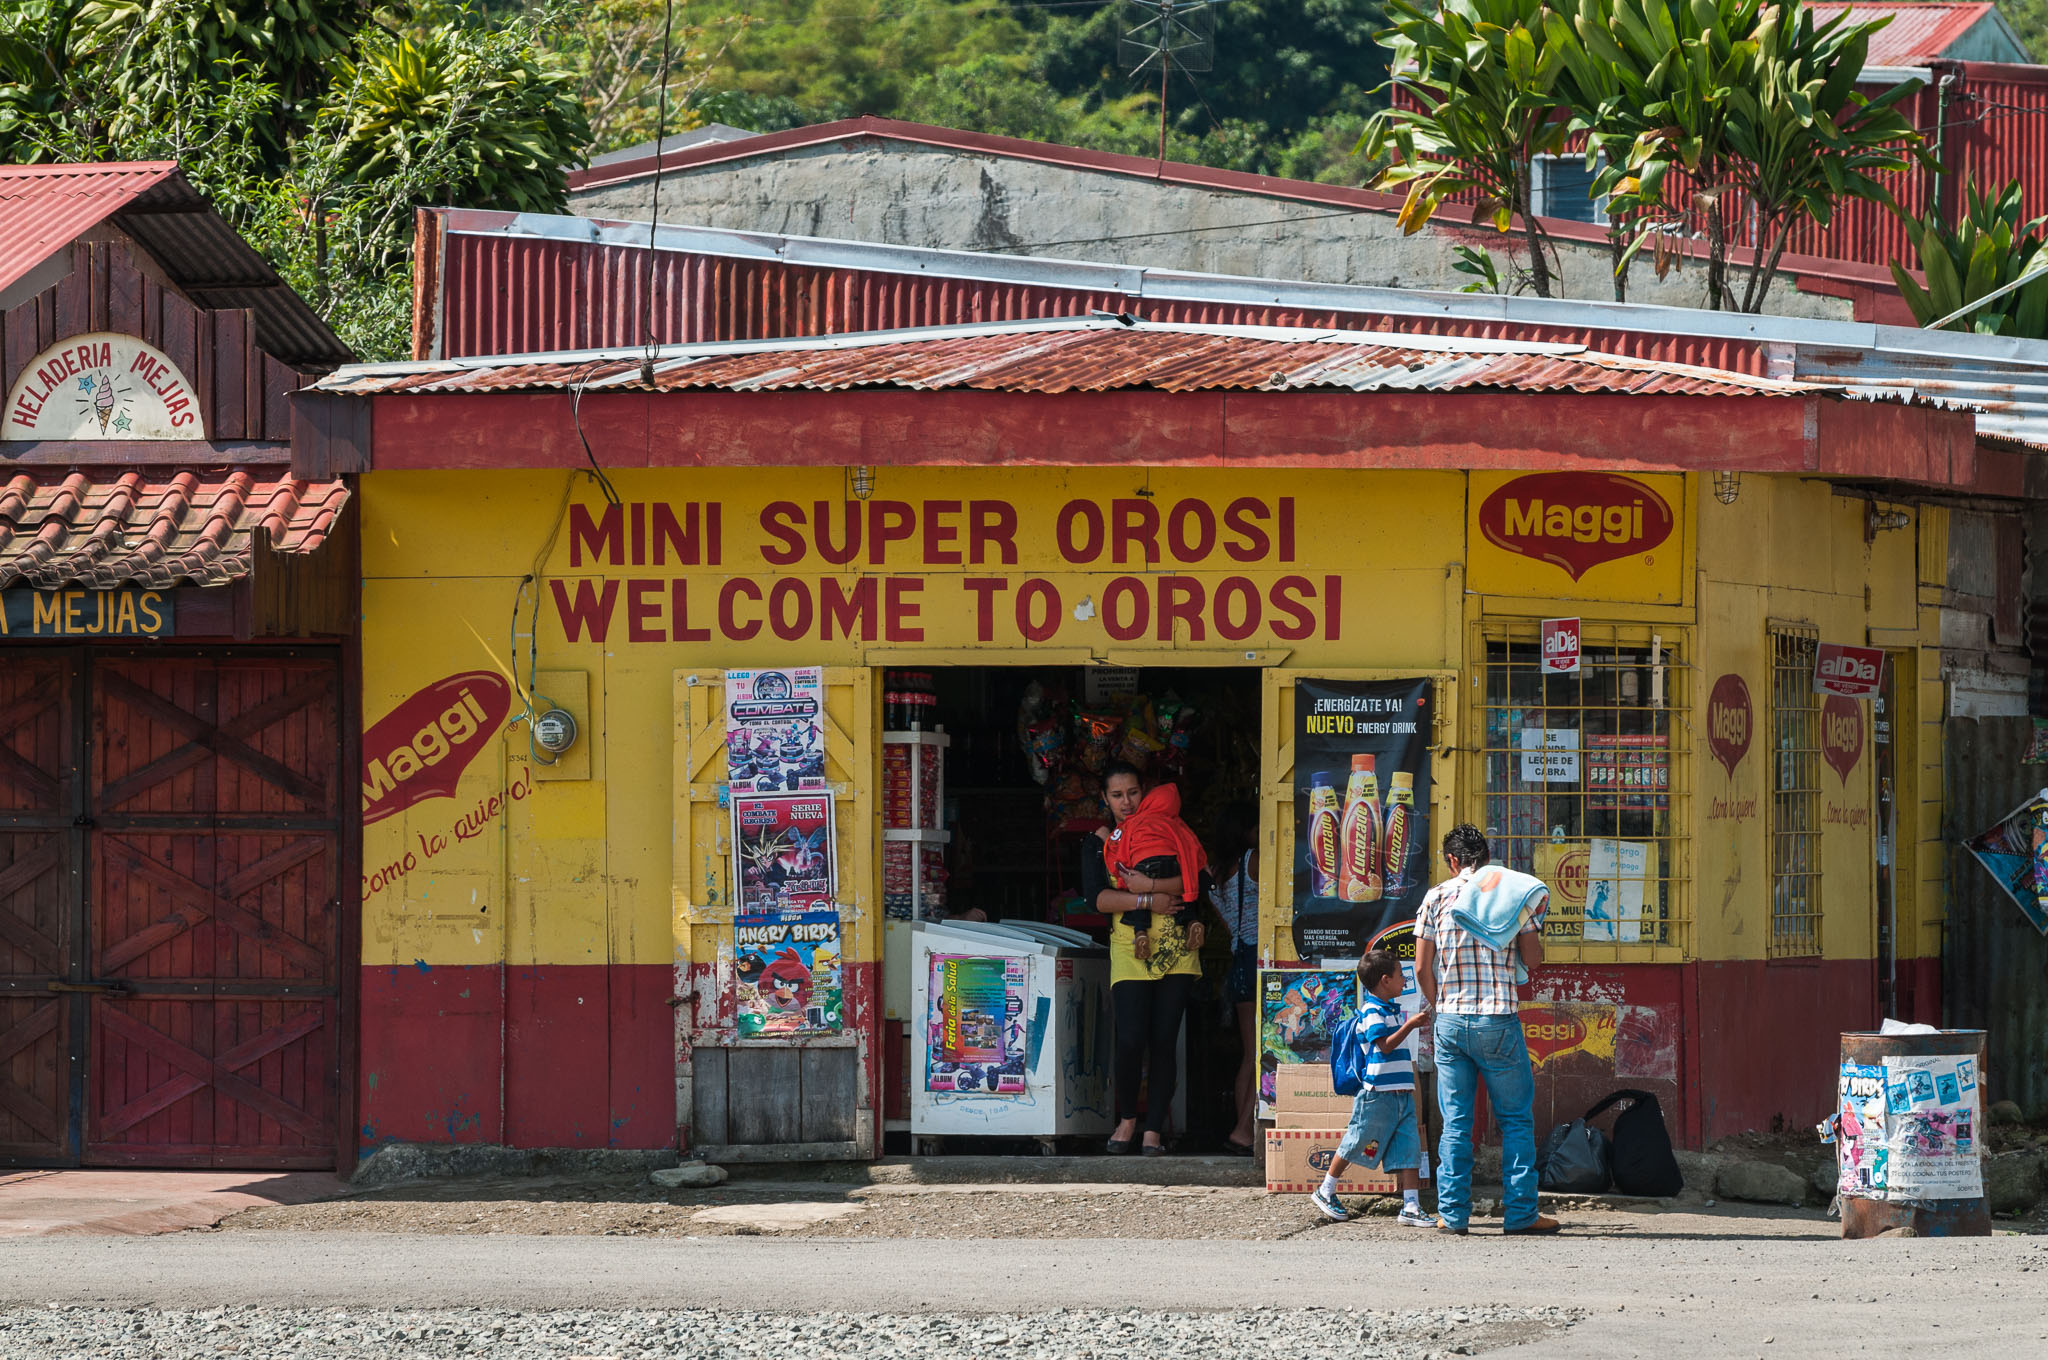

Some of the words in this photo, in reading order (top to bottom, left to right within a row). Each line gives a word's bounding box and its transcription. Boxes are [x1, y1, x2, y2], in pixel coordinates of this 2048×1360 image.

[11, 342, 112, 428] HELADERIA
[130, 350, 195, 427] MEJIAS
[569, 501, 722, 567] MINI
[759, 499, 1018, 566] SUPER
[1055, 496, 1295, 564] OROSI
[1504, 498, 1644, 544] Maggi
[33, 591, 163, 634] MEJIAS
[549, 576, 925, 643] WELCOME
[963, 577, 1062, 642] TO
[1101, 574, 1342, 642] OROSI
[1546, 630, 1577, 653] alDía
[1821, 656, 1876, 680] alDía
[734, 702, 815, 716] COMBATE
[1314, 696, 1382, 714] ¡ENERGÍZATE
[1384, 699, 1402, 712] YA!
[1306, 715, 1354, 734] NUEVO
[1357, 722, 1390, 734] ENERGY
[1392, 722, 1416, 734] DRINK
[1712, 701, 1747, 746] Maggi
[1826, 710, 1858, 752] Maggi
[362, 687, 488, 812] Maggi
[1528, 756, 1558, 764] LECHE
[790, 812, 824, 820] NUEVA
[792, 804, 822, 812] SERIE
[418, 832, 447, 859] la
[1322, 814, 1336, 874] Lucozade
[1352, 804, 1368, 876] Lucozade
[1386, 806, 1405, 873] Lucozade
[738, 924, 788, 945] ANGRY
[790, 922, 838, 943] BIRDS
[1382, 931, 1398, 942] Precio
[947, 961, 957, 992] Salud
[1267, 982, 1282, 991] 10
[945, 1018, 957, 1050] Feria
[1850, 1076, 1884, 1098] BIRDS
